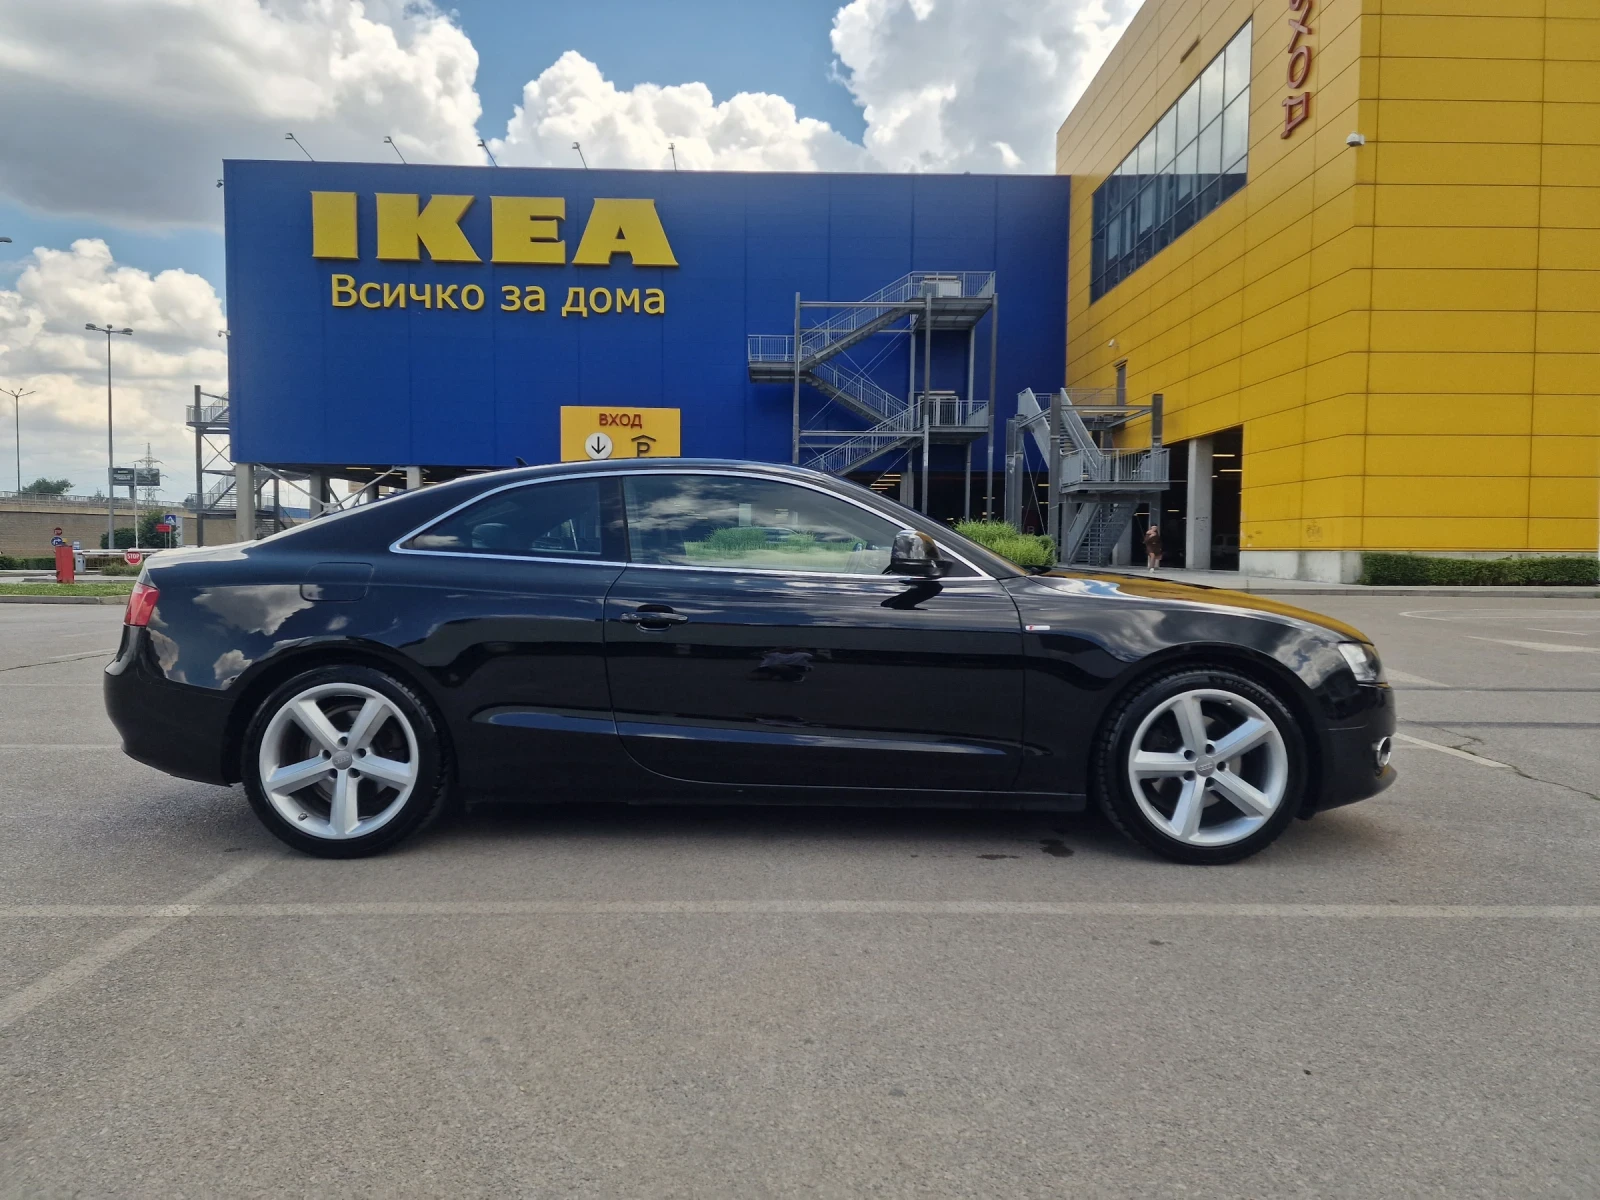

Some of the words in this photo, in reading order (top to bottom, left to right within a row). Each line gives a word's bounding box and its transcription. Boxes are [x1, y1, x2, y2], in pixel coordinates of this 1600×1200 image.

[311, 191, 678, 267] IKEA
[331, 274, 485, 311] Всичко
[500, 284, 546, 312] за
[562, 287, 666, 317] дома
[599, 413, 643, 429] ВХОД
